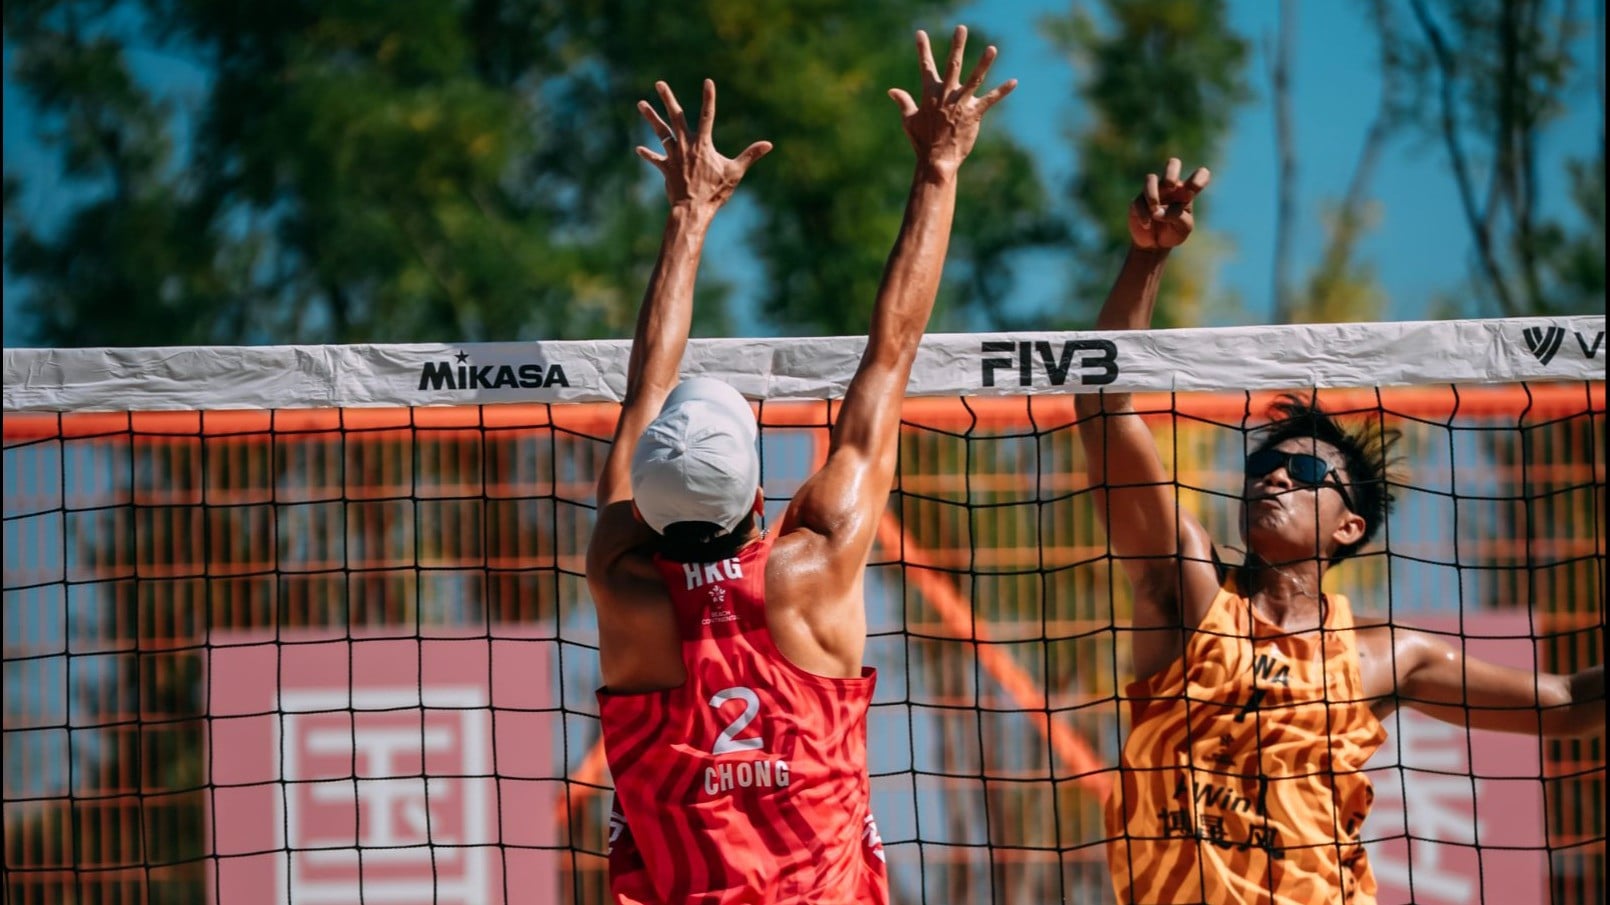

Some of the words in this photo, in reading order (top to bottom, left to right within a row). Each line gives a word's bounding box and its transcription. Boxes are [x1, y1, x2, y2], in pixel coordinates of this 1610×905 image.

[981, 339, 1119, 387] FIVB
[682, 557, 743, 591] HKG
[709, 687, 765, 756] 2
[704, 760, 790, 796] CHONG
